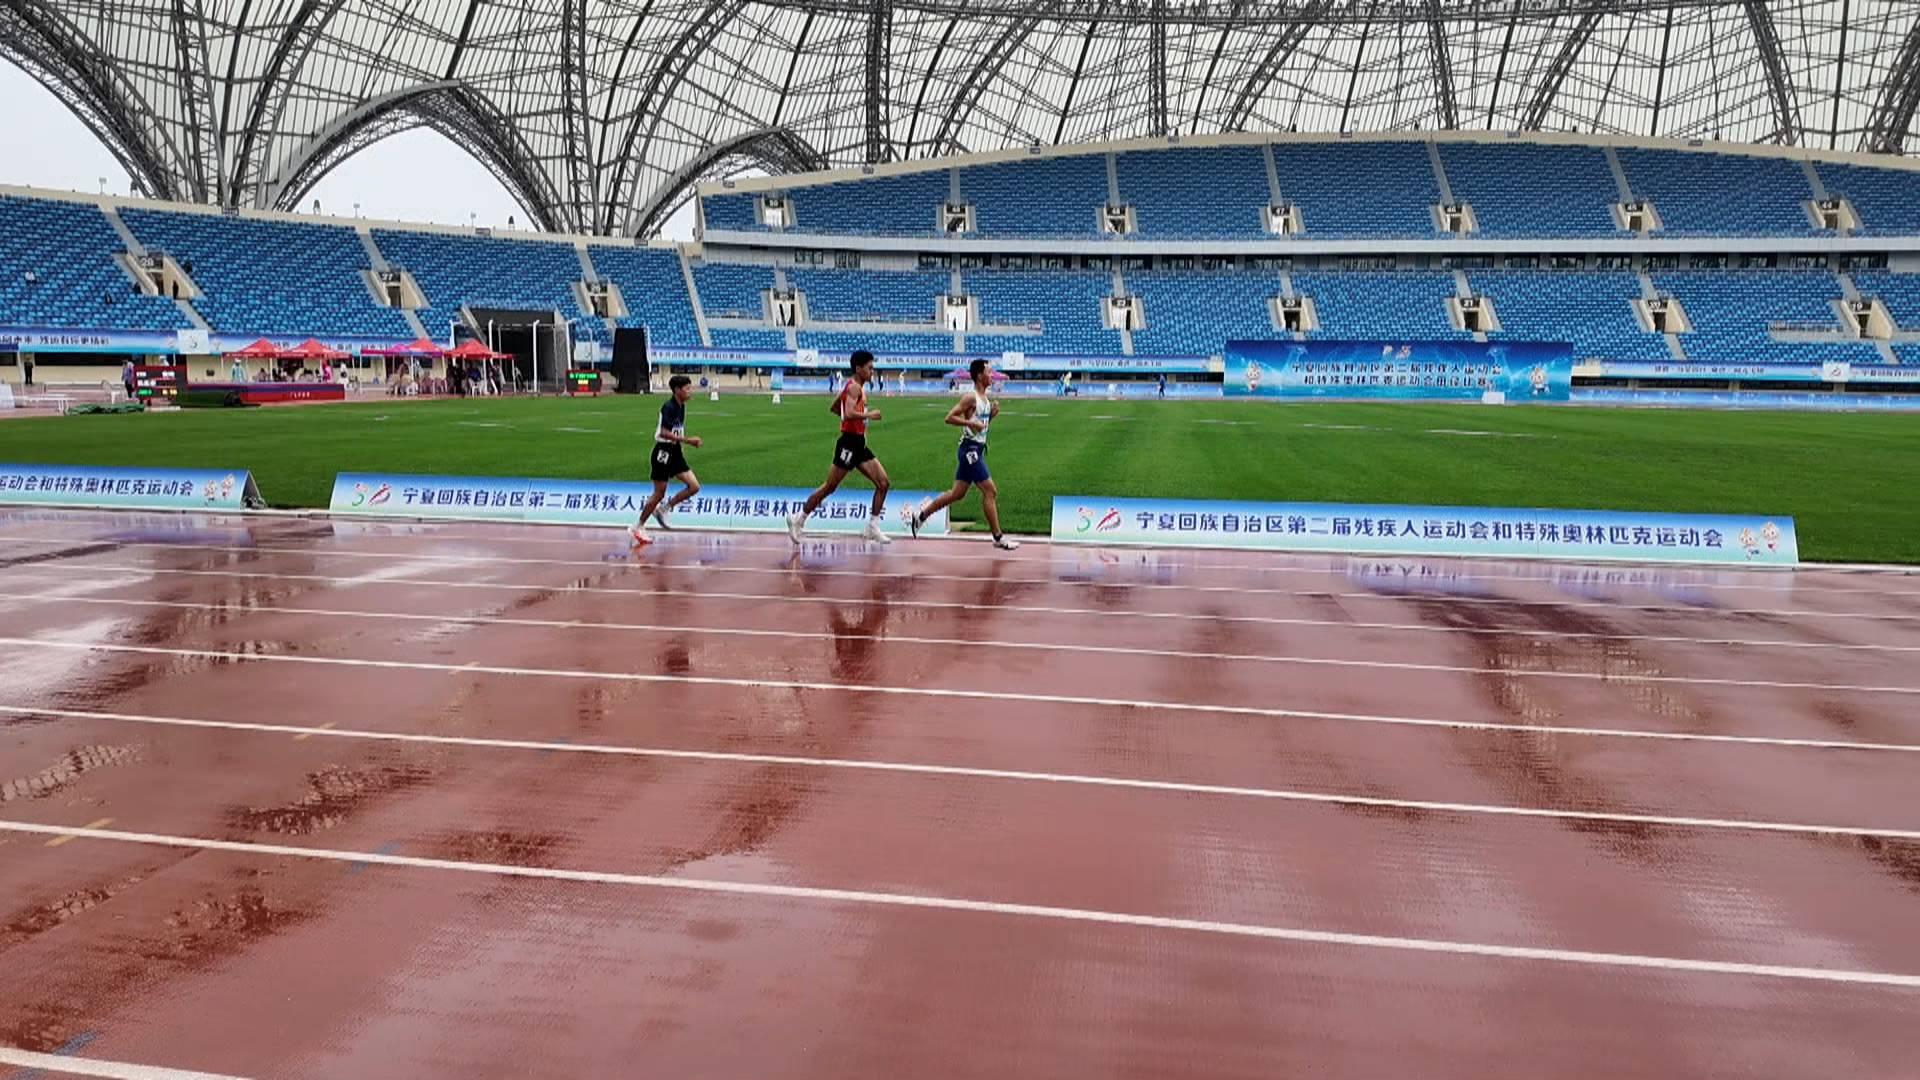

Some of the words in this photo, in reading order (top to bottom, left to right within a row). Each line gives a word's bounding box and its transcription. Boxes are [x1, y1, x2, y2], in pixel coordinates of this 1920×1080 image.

[1136, 512, 1723, 548] 宁夏回族自治区第二届残疾人运动会和特殊奥林匹克运动会
